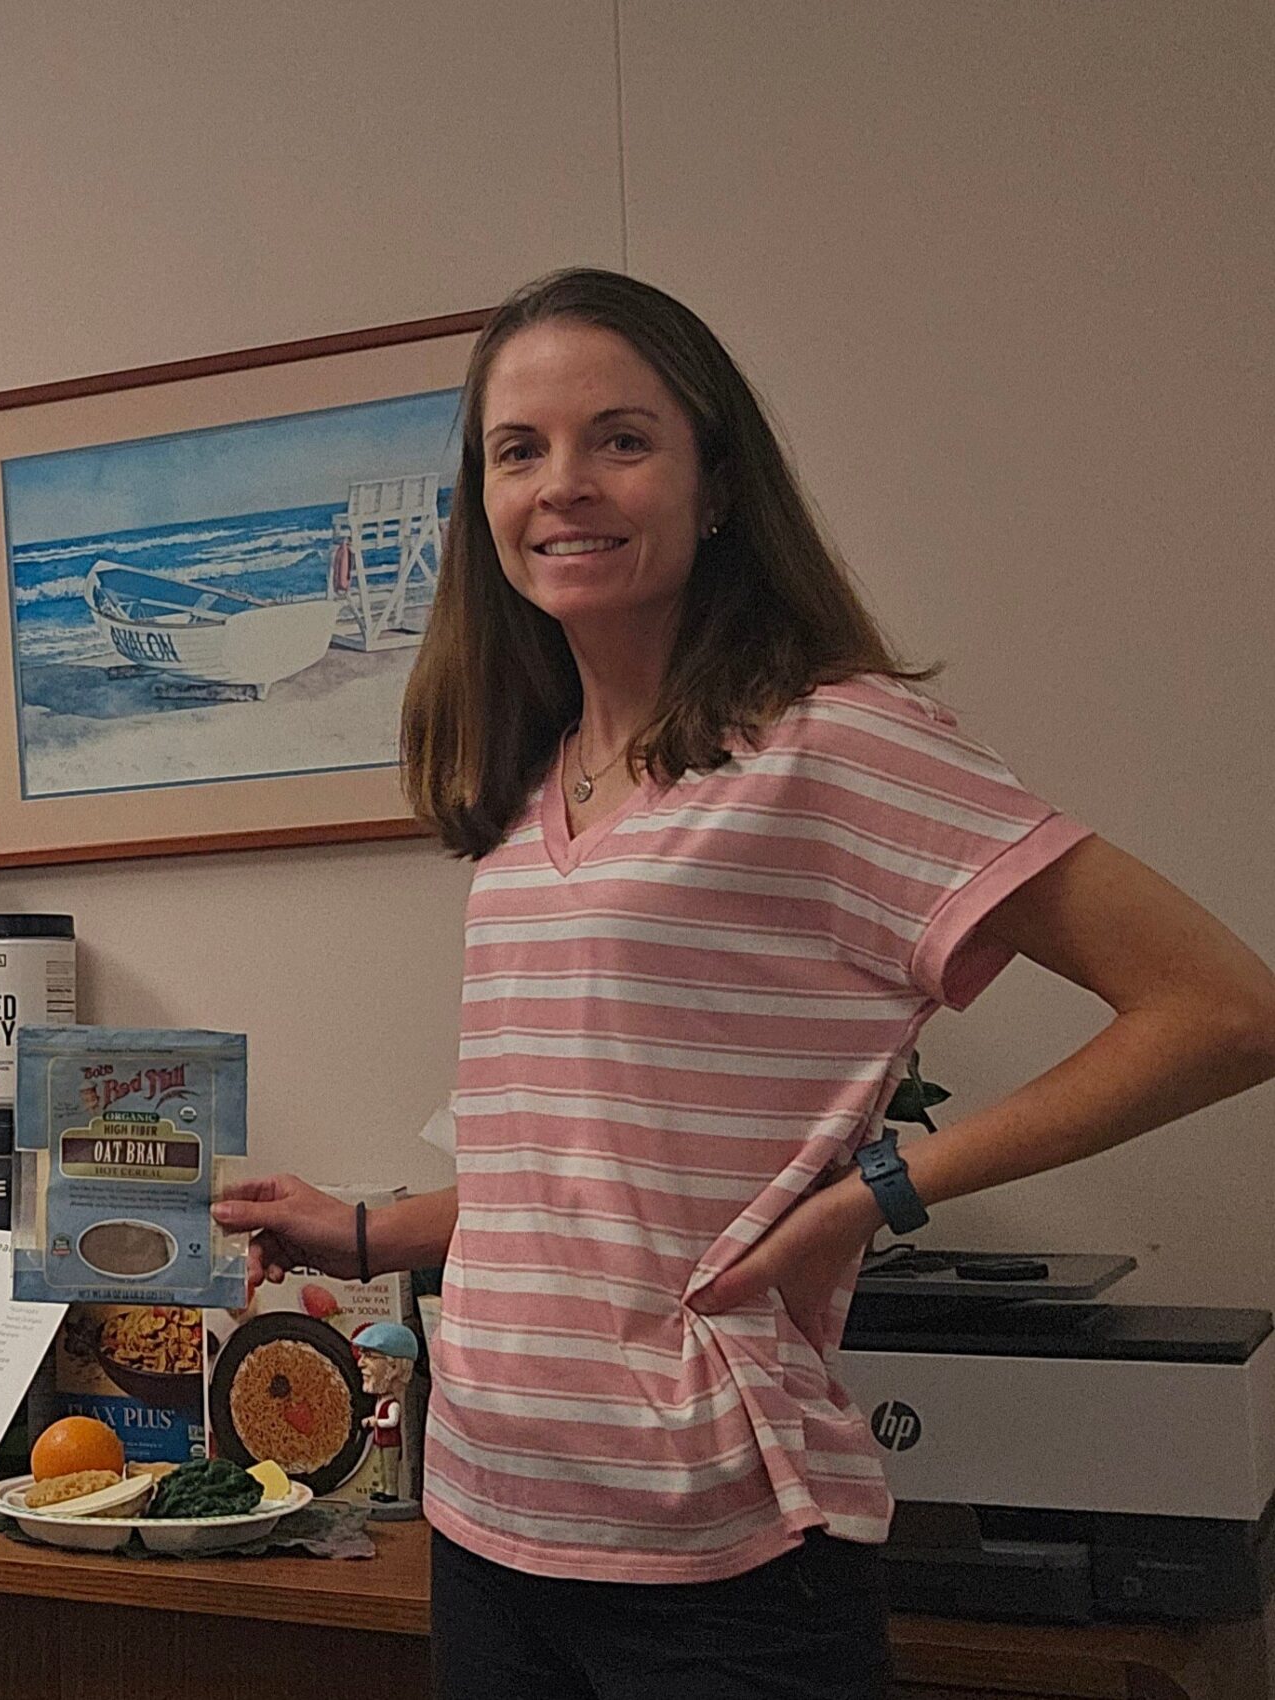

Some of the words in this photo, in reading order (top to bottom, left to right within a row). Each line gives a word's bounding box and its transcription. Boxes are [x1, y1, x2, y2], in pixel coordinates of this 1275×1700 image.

[102, 1070, 143, 1110] Red
[144, 1063, 186, 1100] Mill
[106, 1112, 157, 1122] ORGANIC
[104, 1124, 126, 1135] HIGH
[131, 1125, 158, 1136] FIBER
[94, 1140, 121, 1163] OAT
[126, 1142, 166, 1165] BRAN
[95, 1166, 118, 1176] HOT
[121, 1167, 162, 1178] CEREAL
[352, 1296, 372, 1304] LOW
[358, 1306, 390, 1316] SODIUM
[123, 1407, 172, 1429] PLUS
[878, 1401, 915, 1451] hp
